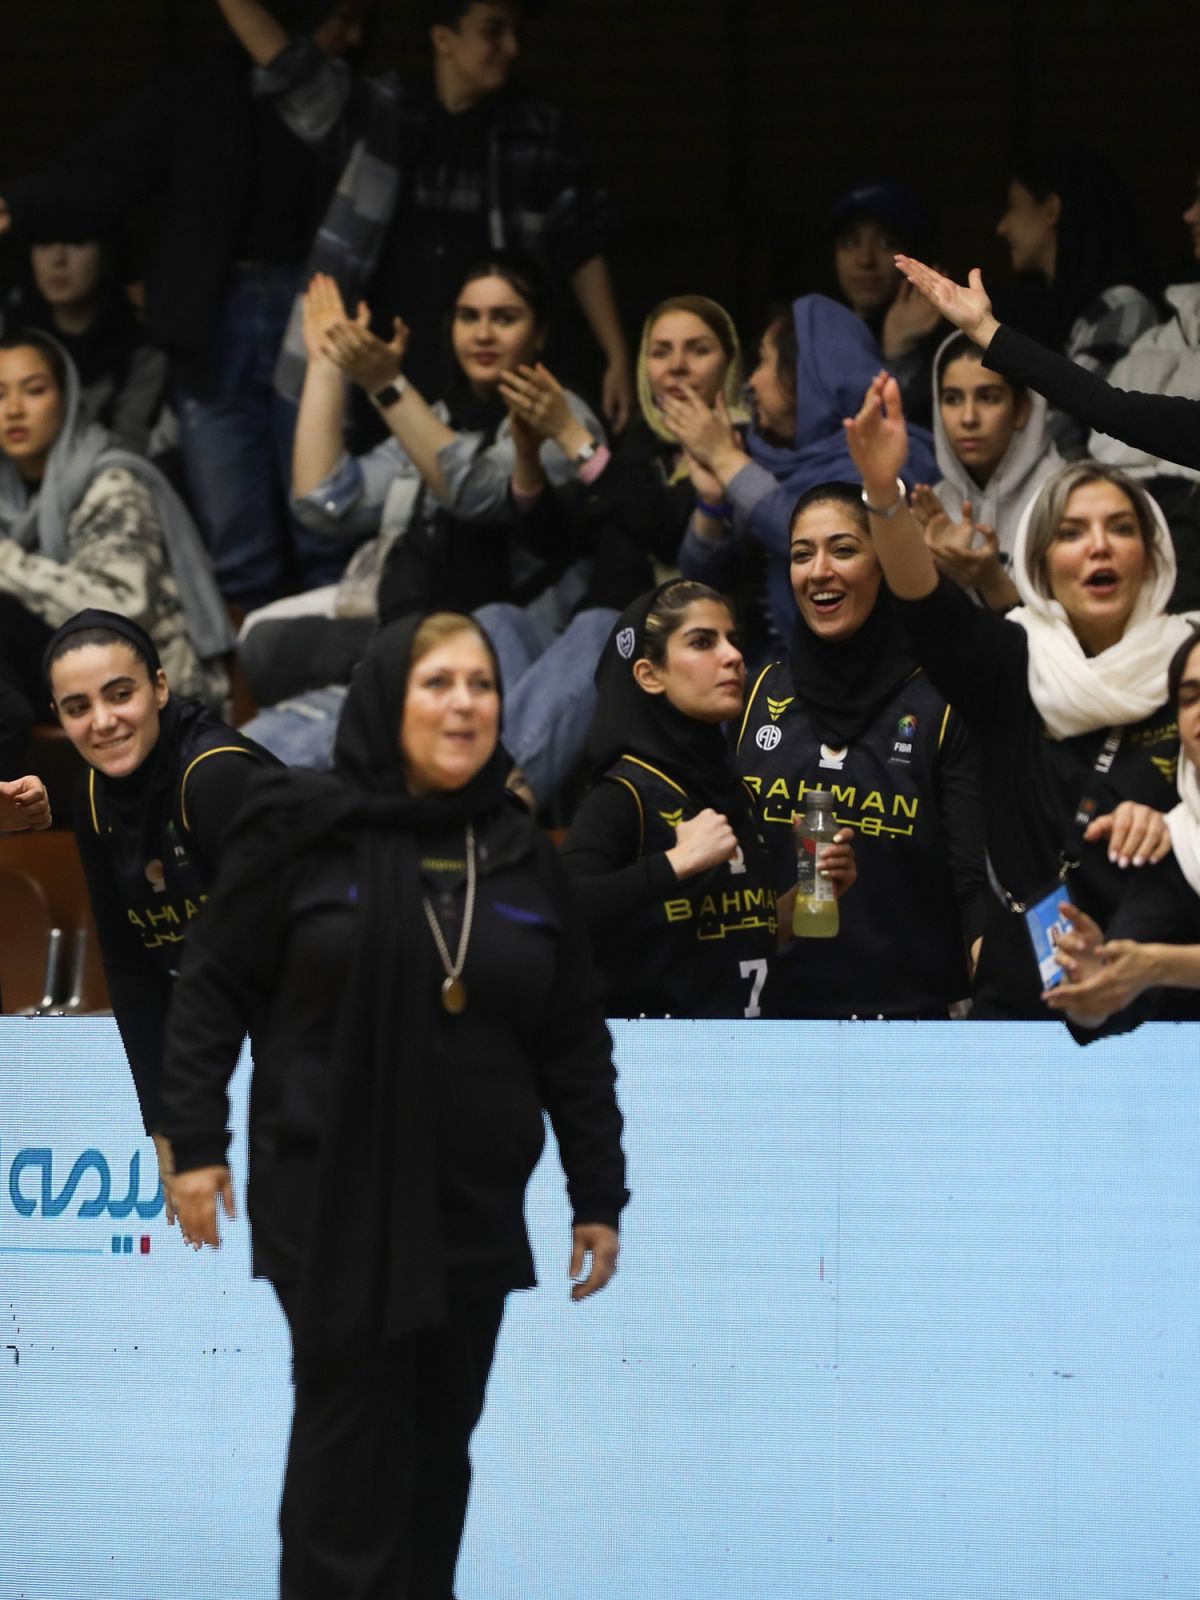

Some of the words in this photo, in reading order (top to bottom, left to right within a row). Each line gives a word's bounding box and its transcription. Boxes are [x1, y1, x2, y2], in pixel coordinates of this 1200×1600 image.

[894, 742, 912, 753] FIBA
[764, 806, 913, 839] بهن
[128, 895, 207, 928] AHMA
[739, 958, 768, 1018] 7
